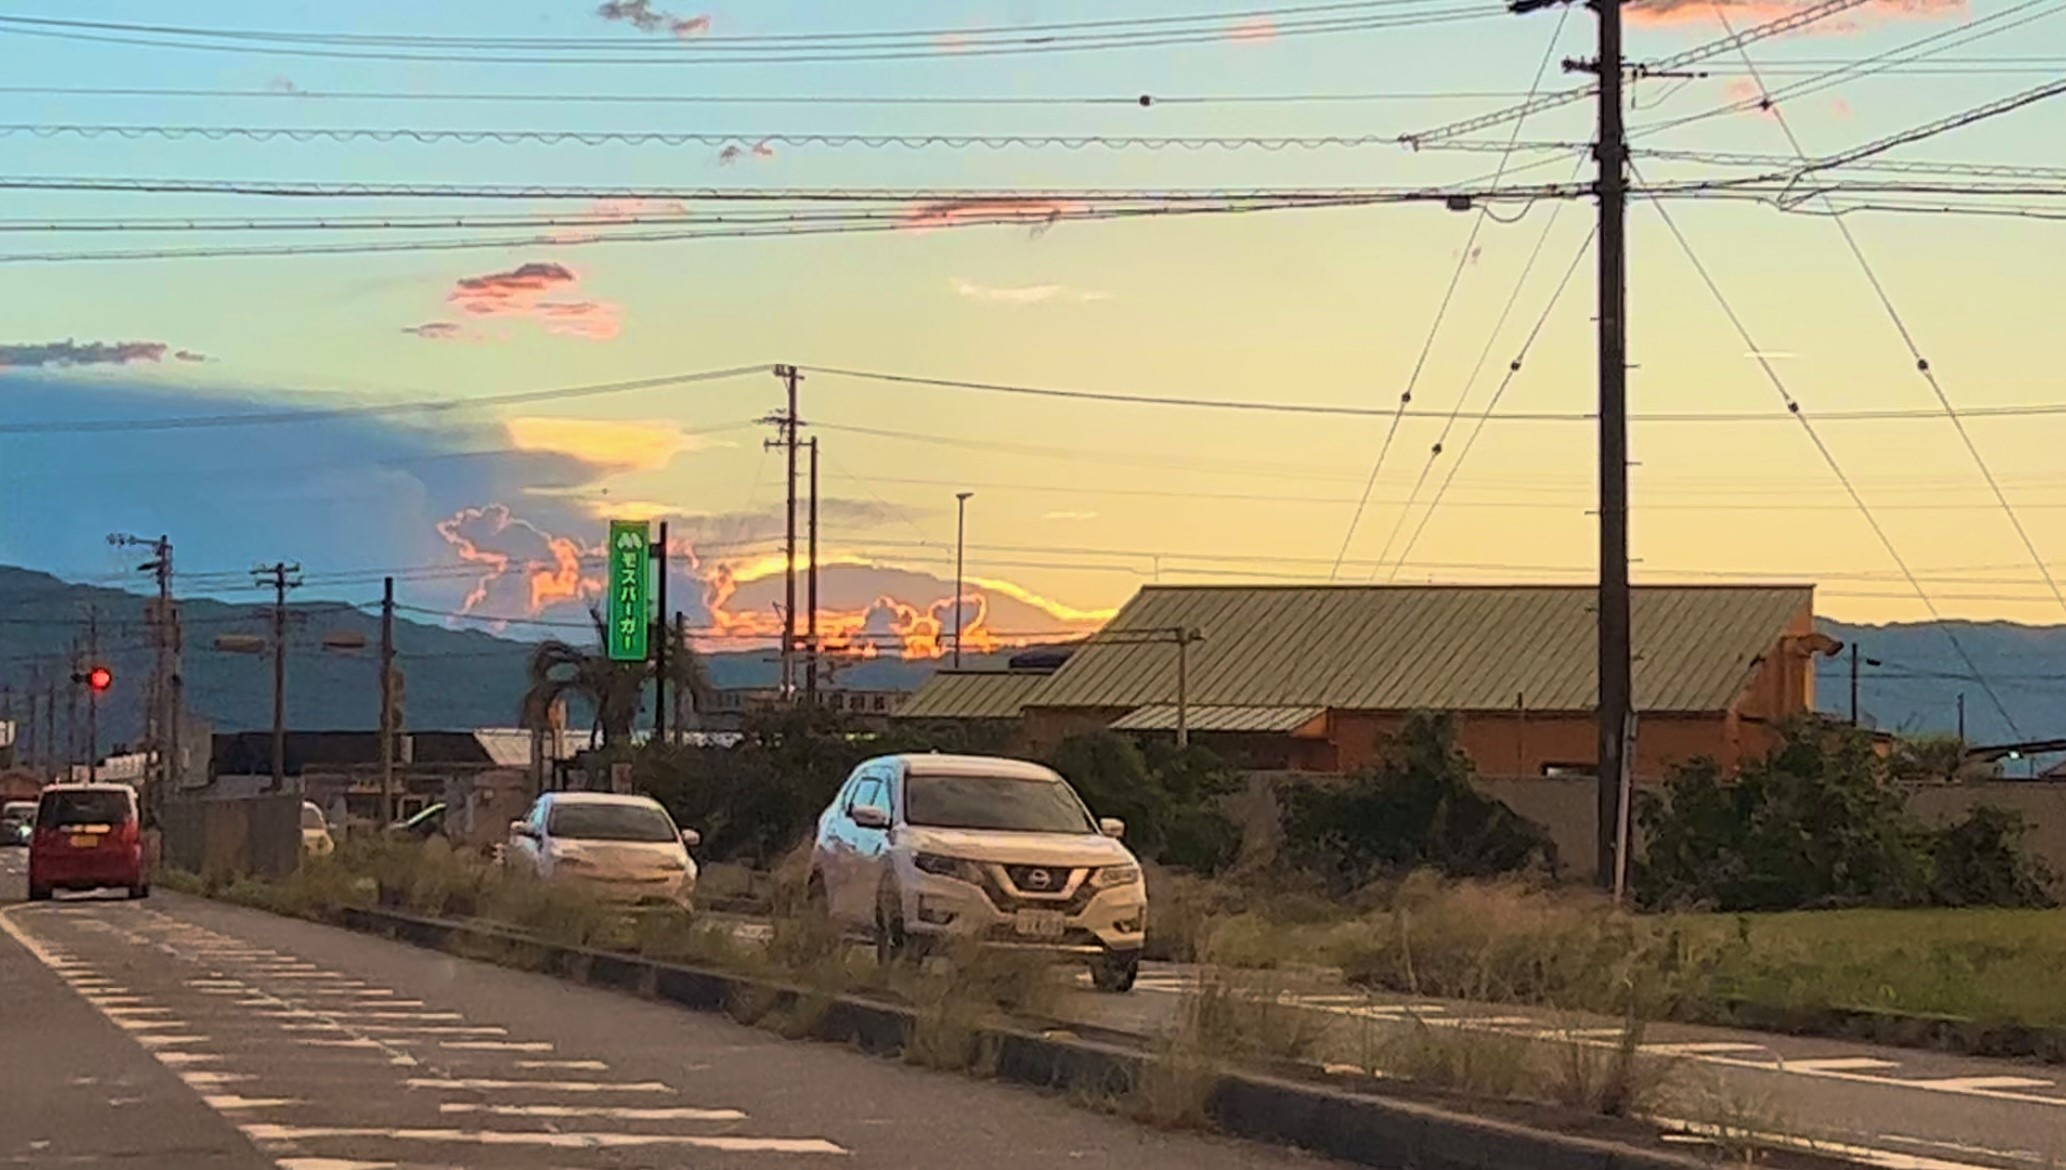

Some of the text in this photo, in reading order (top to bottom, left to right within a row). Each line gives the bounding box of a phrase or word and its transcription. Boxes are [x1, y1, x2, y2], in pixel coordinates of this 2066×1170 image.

[620, 552, 636, 650] モスバーガー
